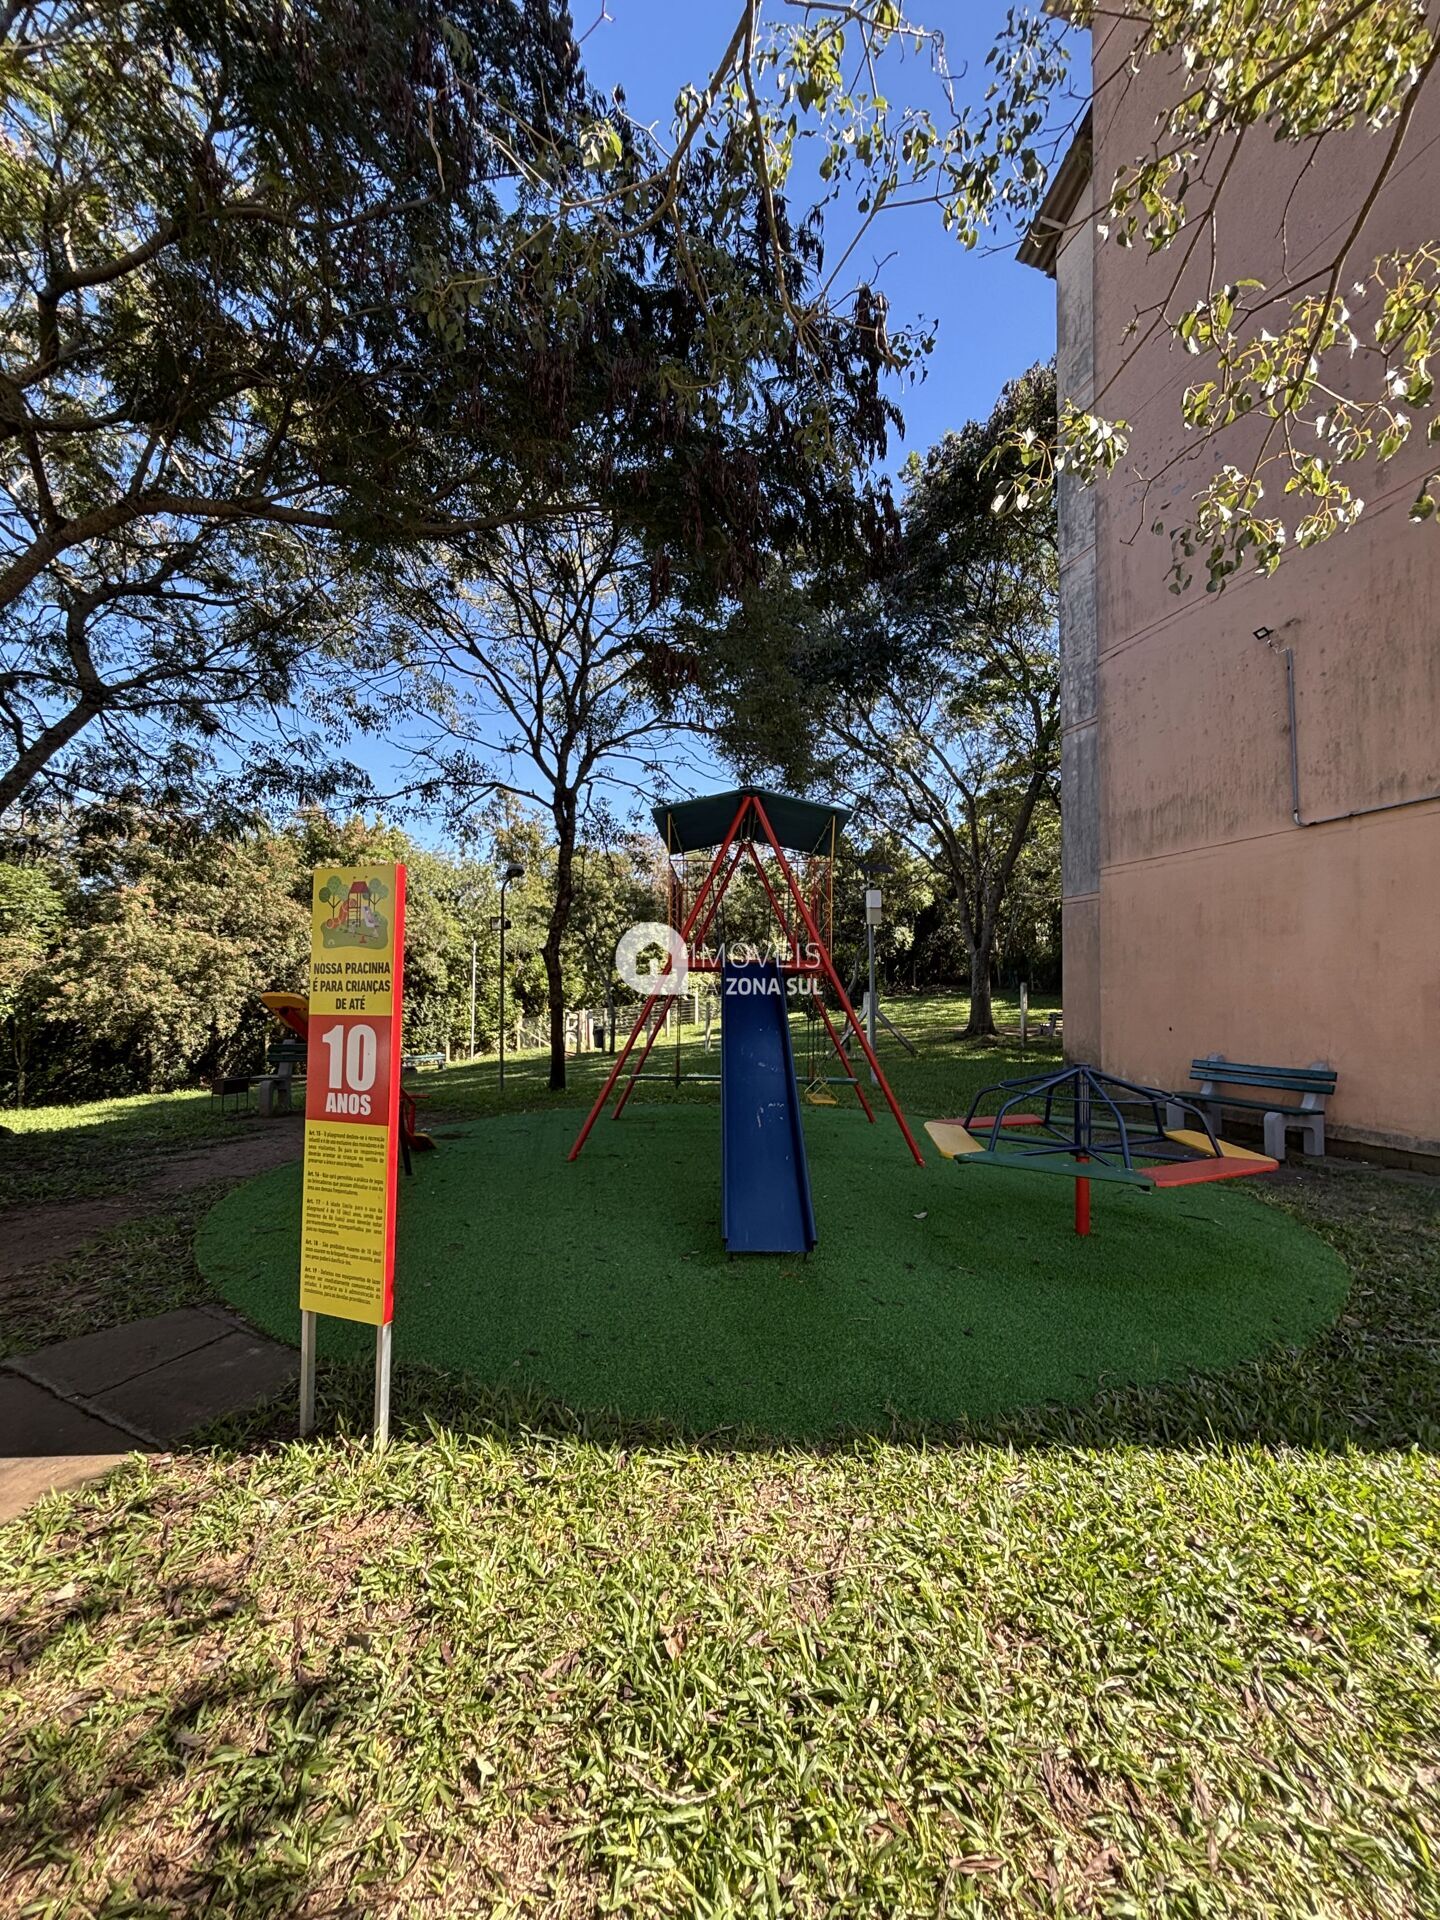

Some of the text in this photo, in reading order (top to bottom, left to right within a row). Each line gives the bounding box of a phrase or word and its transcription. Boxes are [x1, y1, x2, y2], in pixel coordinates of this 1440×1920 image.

[314, 962, 390, 975] NOSSA PRACINHA
[313, 978, 390, 994] É PARA CRIANÇAS
[335, 995, 365, 1010] DE ATÉ
[322, 1024, 376, 1092] 10
[326, 1093, 371, 1116] ANOS
